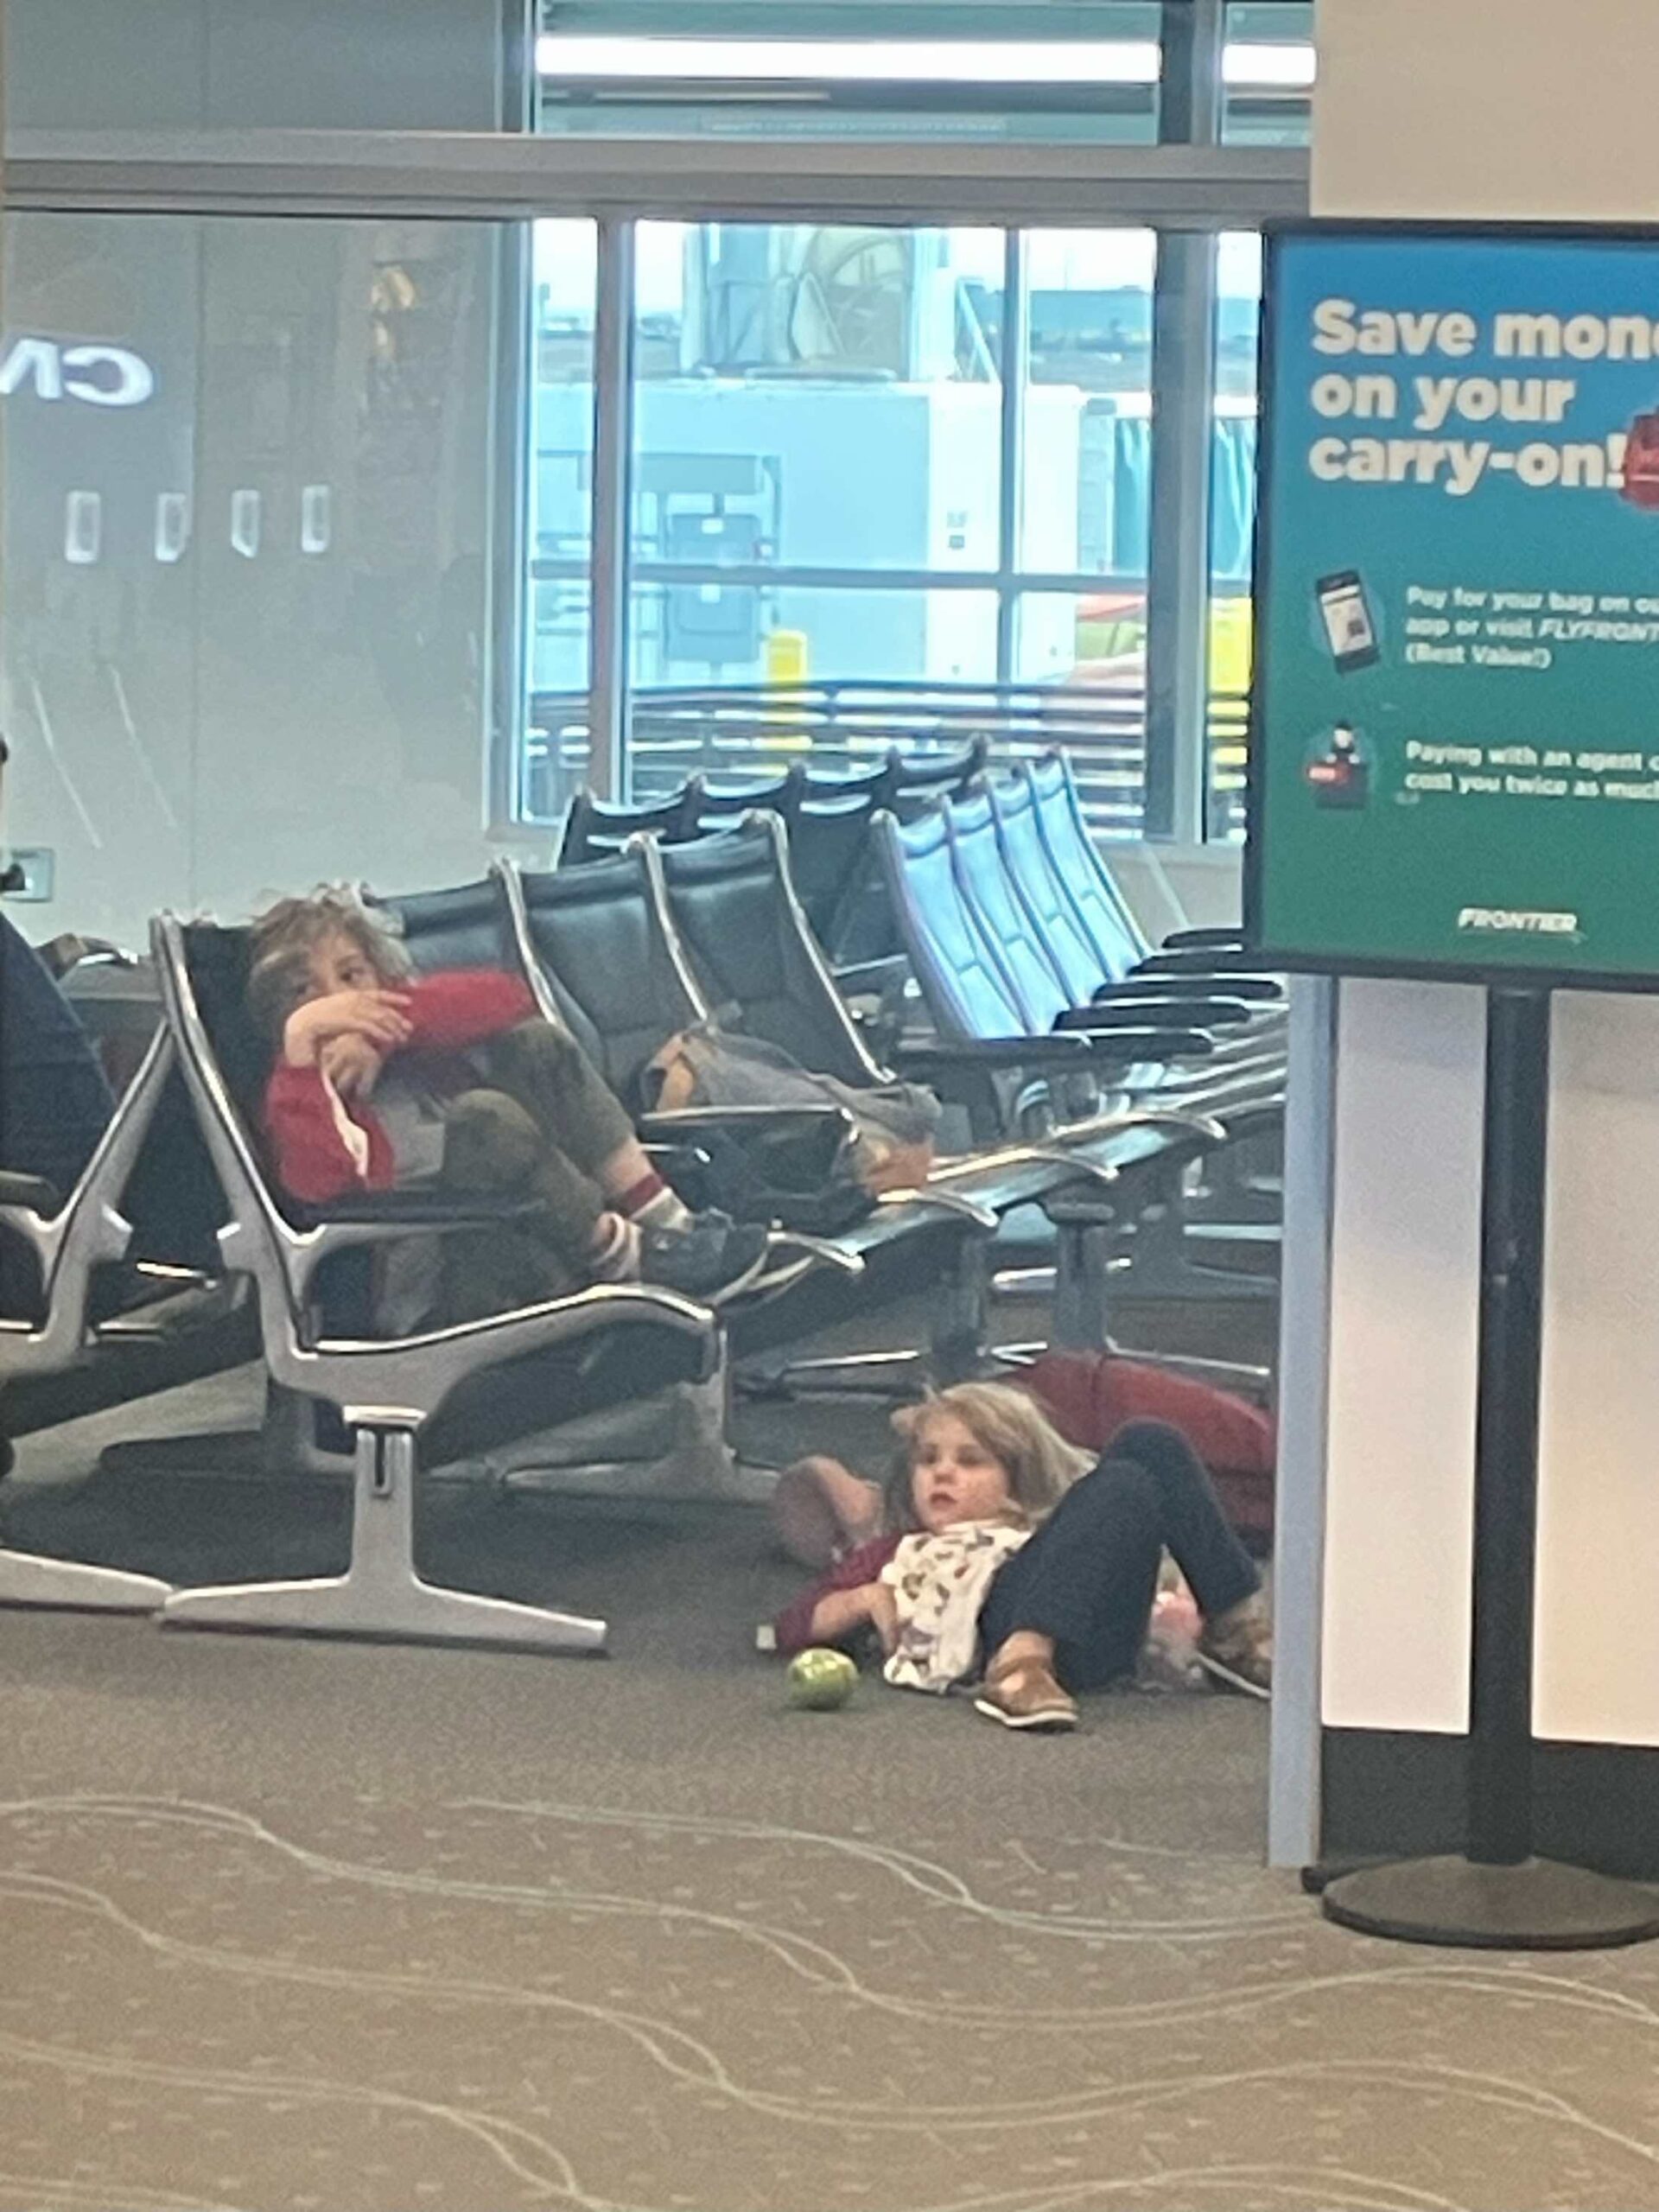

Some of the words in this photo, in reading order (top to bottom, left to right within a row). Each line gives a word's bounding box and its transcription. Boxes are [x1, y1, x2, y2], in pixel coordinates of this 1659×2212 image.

[1312, 298, 1477, 357] Save
[1493, 314, 1659, 360] mon
[1311, 373, 1396, 418] on
[1413, 375, 1576, 431] your
[1308, 432, 1629, 495] carry-on!
[1407, 586, 1446, 609] Pay
[1453, 588, 1487, 607] for
[1492, 593, 1542, 611] your
[1549, 592, 1594, 614] bag
[1599, 596, 1630, 612] on
[1406, 618, 1450, 637] app
[1455, 620, 1479, 636] or
[1486, 618, 1533, 638] visit
[1406, 643, 1465, 664] (Best
[1406, 740, 1482, 766] Paying
[1489, 747, 1537, 766] with
[1544, 750, 1572, 766] an
[1576, 751, 1642, 772] agent
[1405, 773, 1452, 791] cost
[1459, 777, 1500, 794] you
[1506, 775, 1567, 796] twice
[1573, 780, 1599, 797] as
[1459, 908, 1577, 931] FRONTIER
